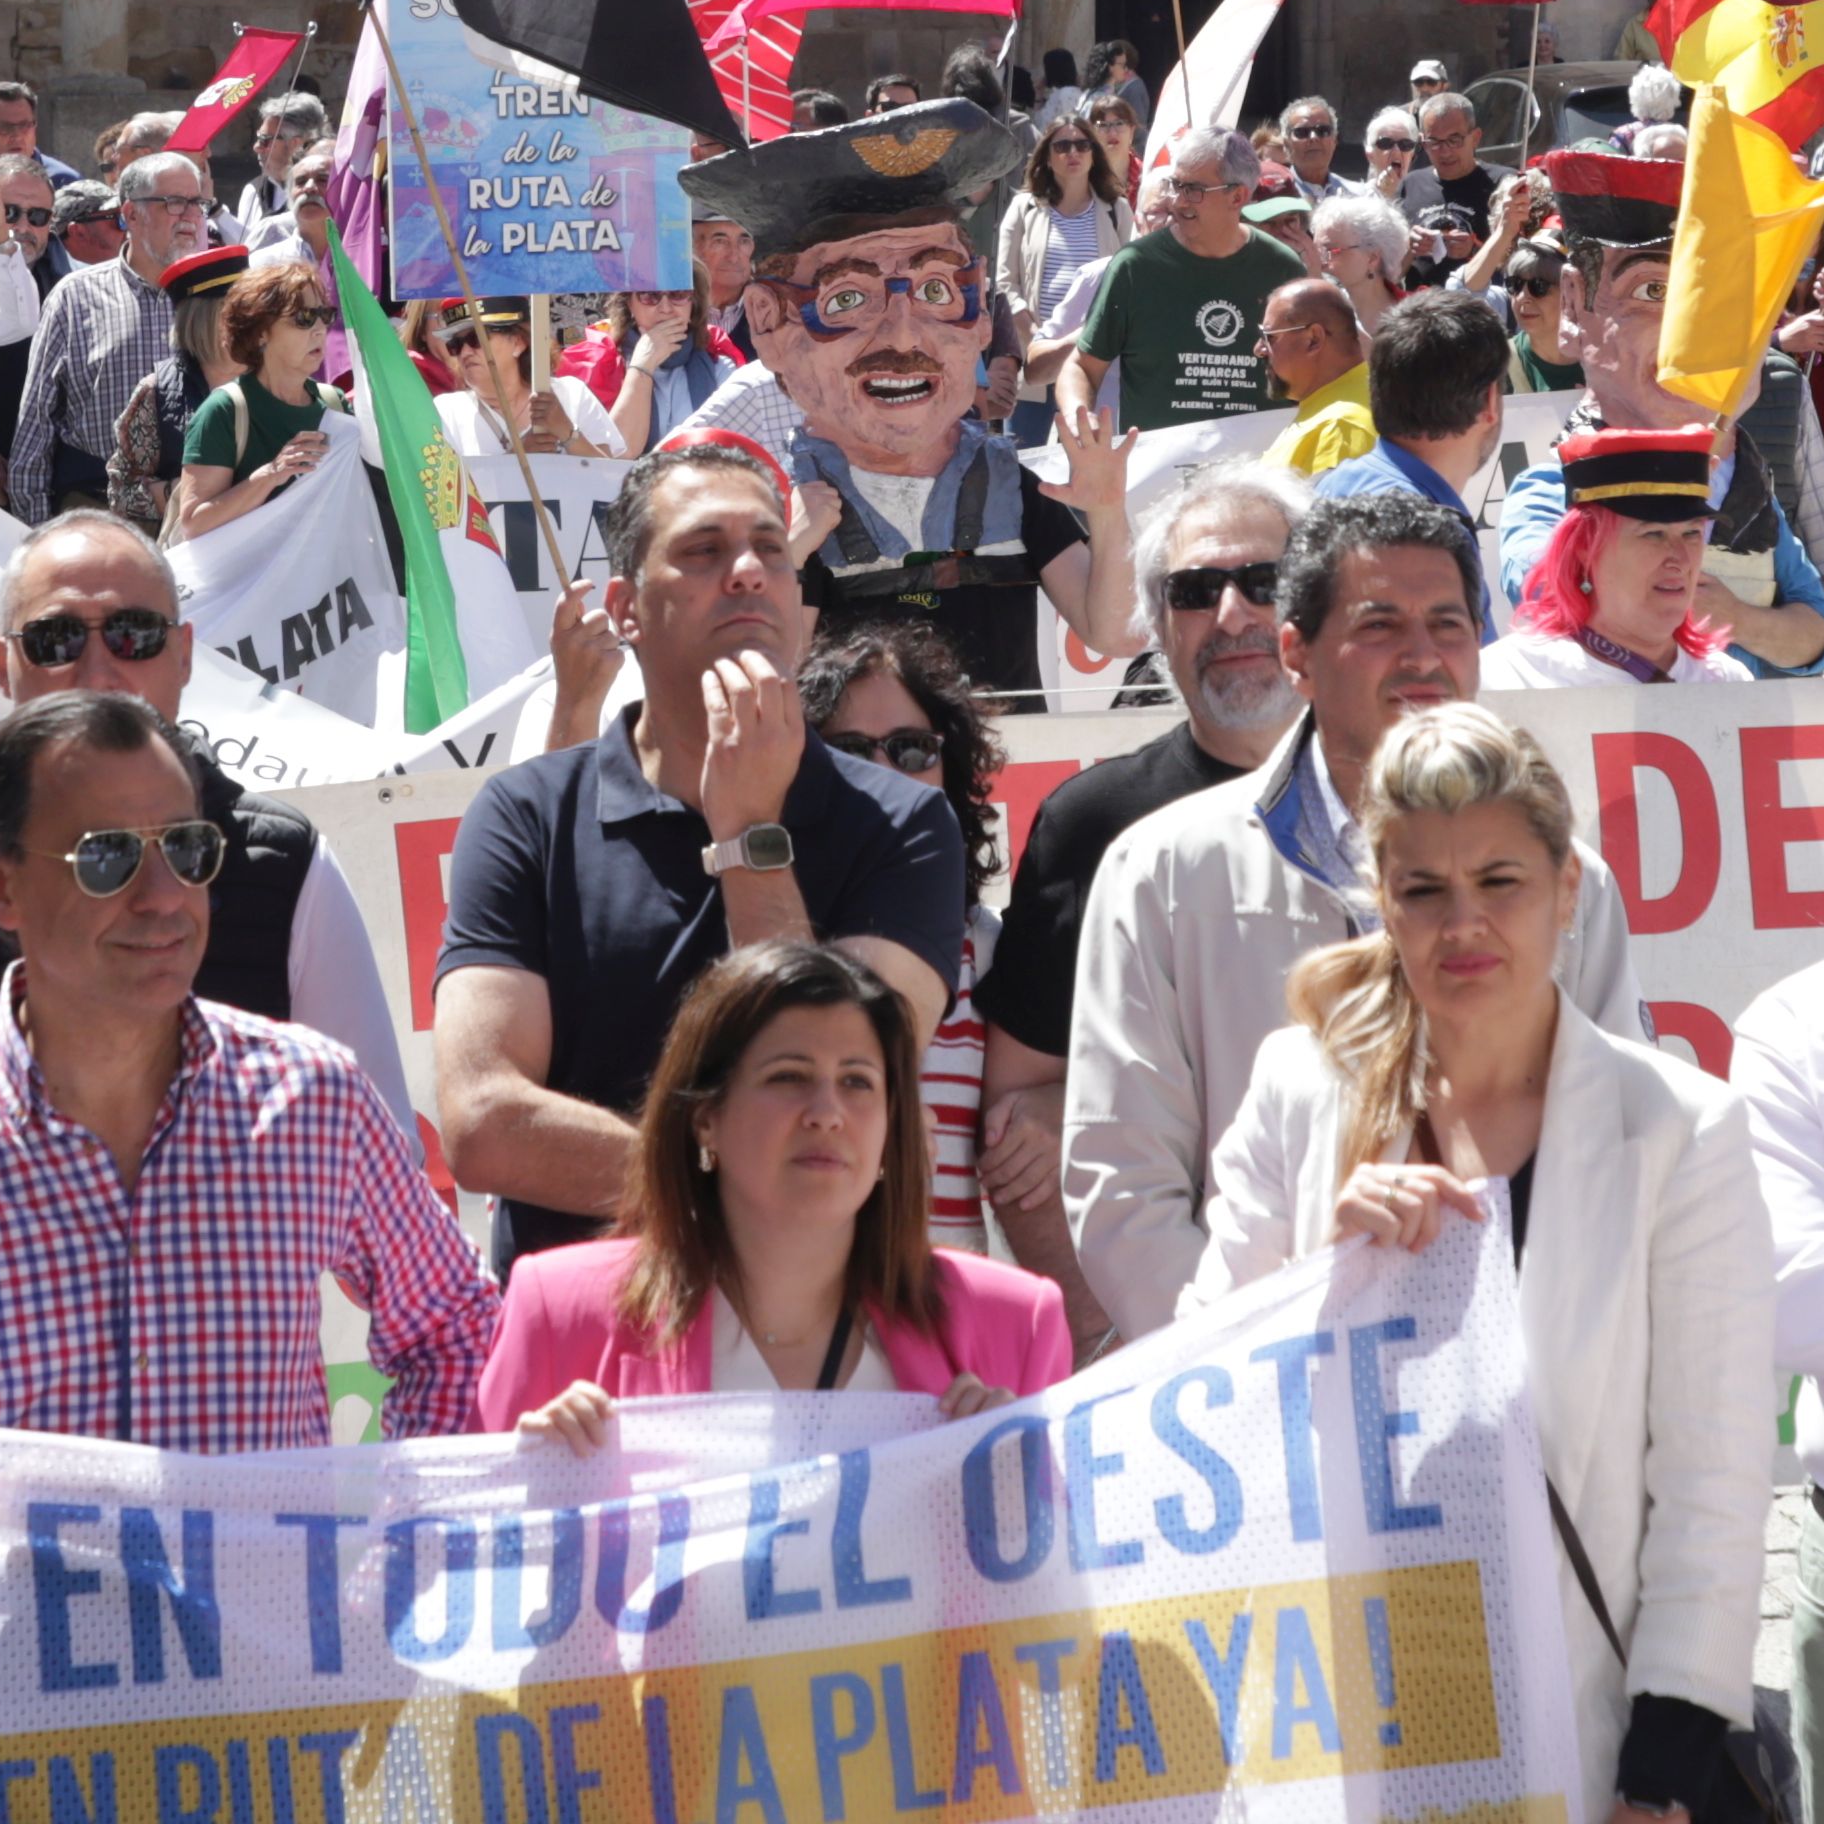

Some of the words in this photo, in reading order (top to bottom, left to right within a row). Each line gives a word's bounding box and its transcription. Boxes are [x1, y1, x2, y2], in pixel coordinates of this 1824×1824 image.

[489, 84, 590, 117] TREN
[503, 131, 542, 164] de
[548, 130, 578, 163] la
[468, 175, 573, 210] RUTA
[580, 174, 619, 207] de
[463, 225, 493, 258] la
[502, 219, 622, 254] PLATA
[1178, 353, 1258, 368] VERTEBRANDO
[1184, 366, 1247, 379] COMARCAS
[26, 1502, 223, 1694] EN
[274, 1486, 692, 1678] TODO
[743, 1448, 913, 1623] EL
[961, 1315, 1444, 1583] OESTE
[474, 1702, 602, 1824] DE
[808, 1631, 1167, 1823] PLATA
